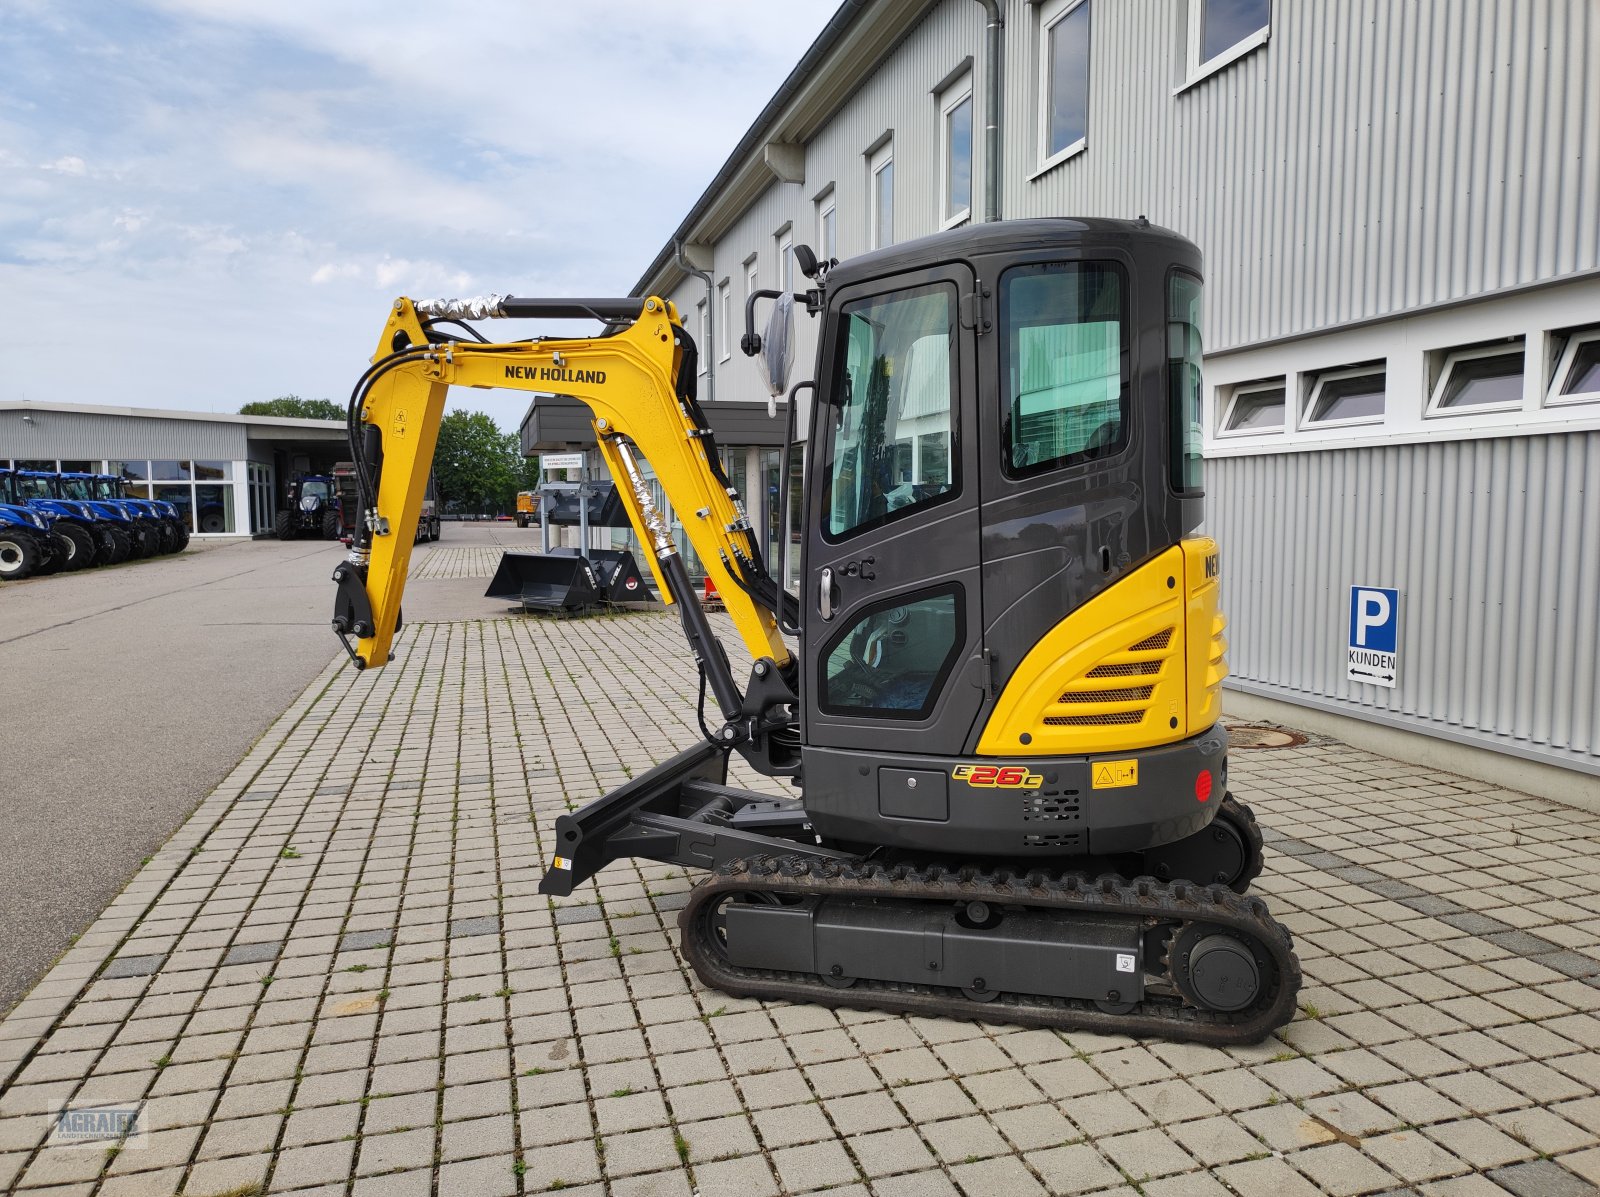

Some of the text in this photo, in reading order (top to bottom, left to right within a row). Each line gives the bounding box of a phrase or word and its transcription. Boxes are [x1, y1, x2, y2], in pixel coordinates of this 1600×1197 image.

[505, 365, 607, 385] NEW HOLLAND
[1356, 589, 1390, 646] P
[1348, 650, 1395, 670] KUNDEN
[953, 765, 1043, 788] E26C
